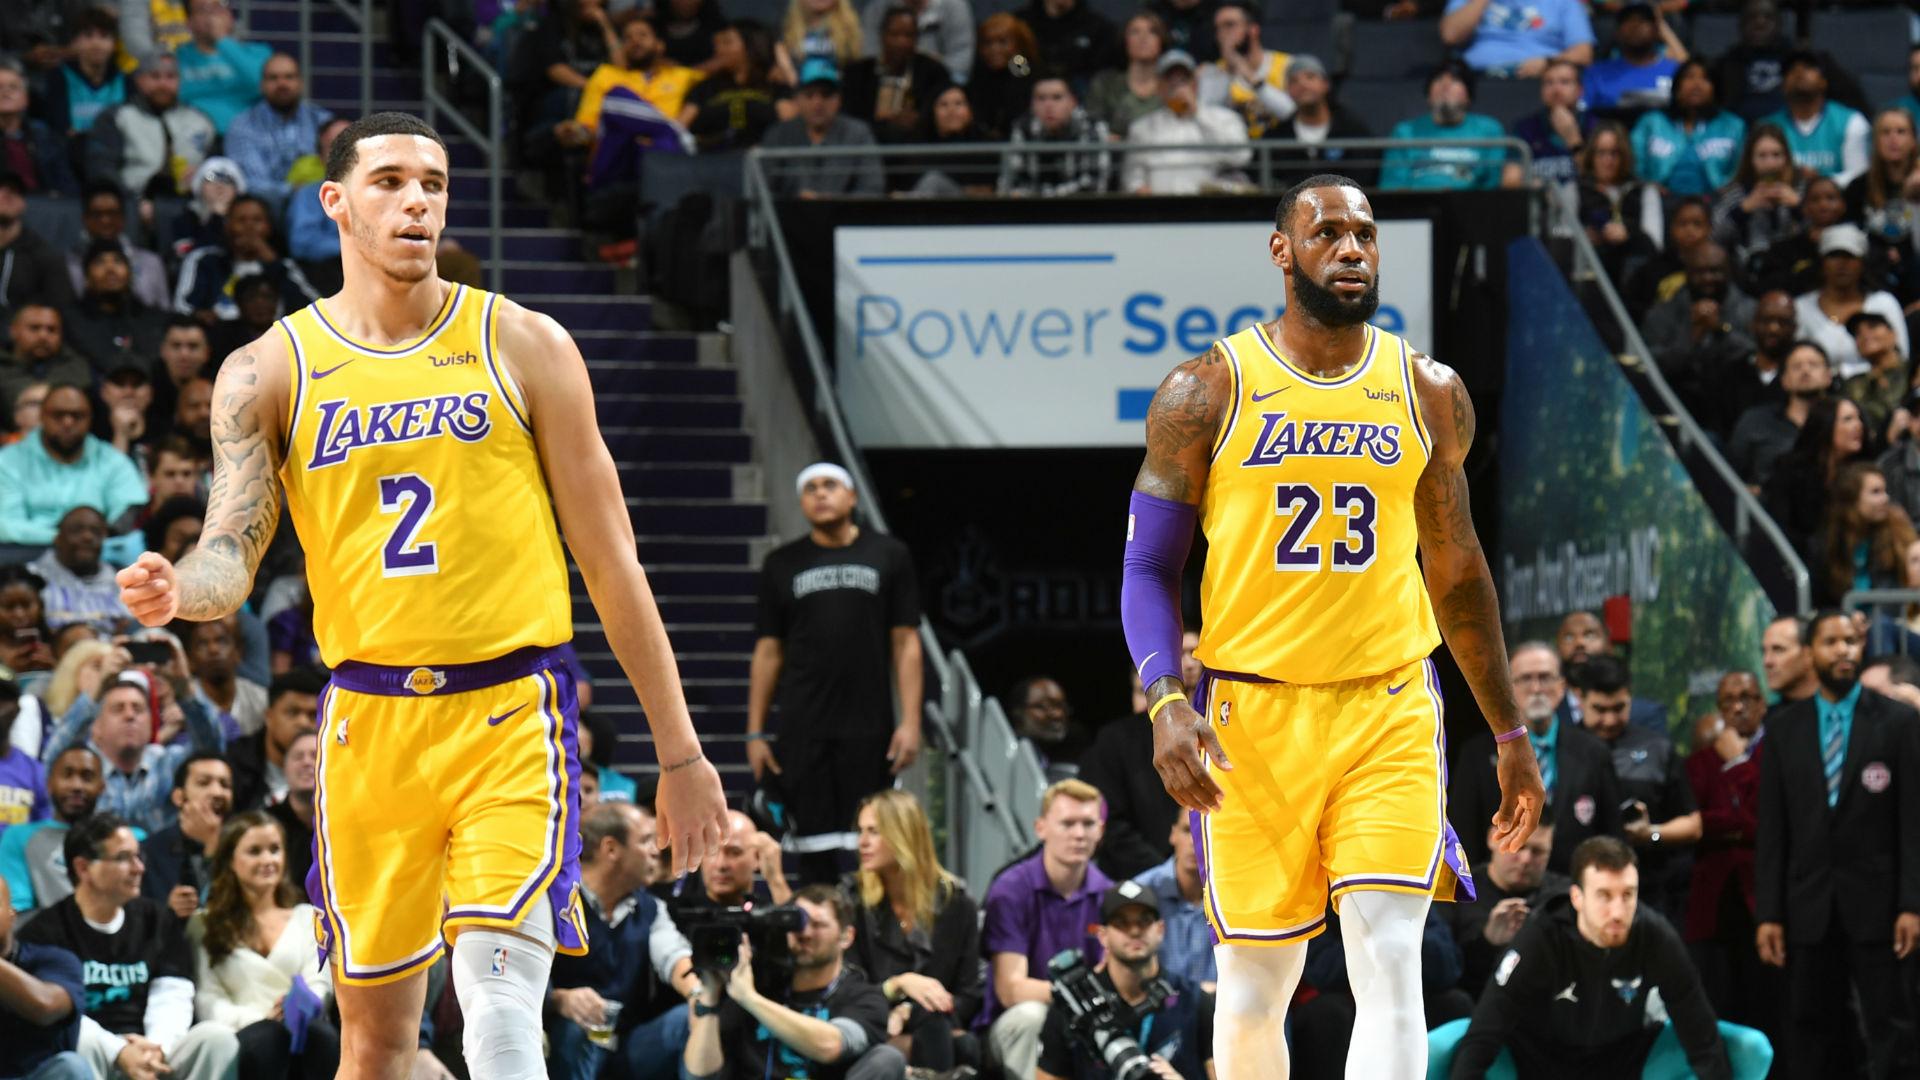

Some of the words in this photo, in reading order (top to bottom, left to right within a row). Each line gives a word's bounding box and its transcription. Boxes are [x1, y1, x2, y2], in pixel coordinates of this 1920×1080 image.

[428, 351, 477, 367] wish
[1363, 387, 1400, 403] wish
[307, 391, 492, 470] LAKERS
[1240, 411, 1402, 469] LAKERS
[377, 472, 439, 579] 2
[1275, 482, 1378, 572] 23
